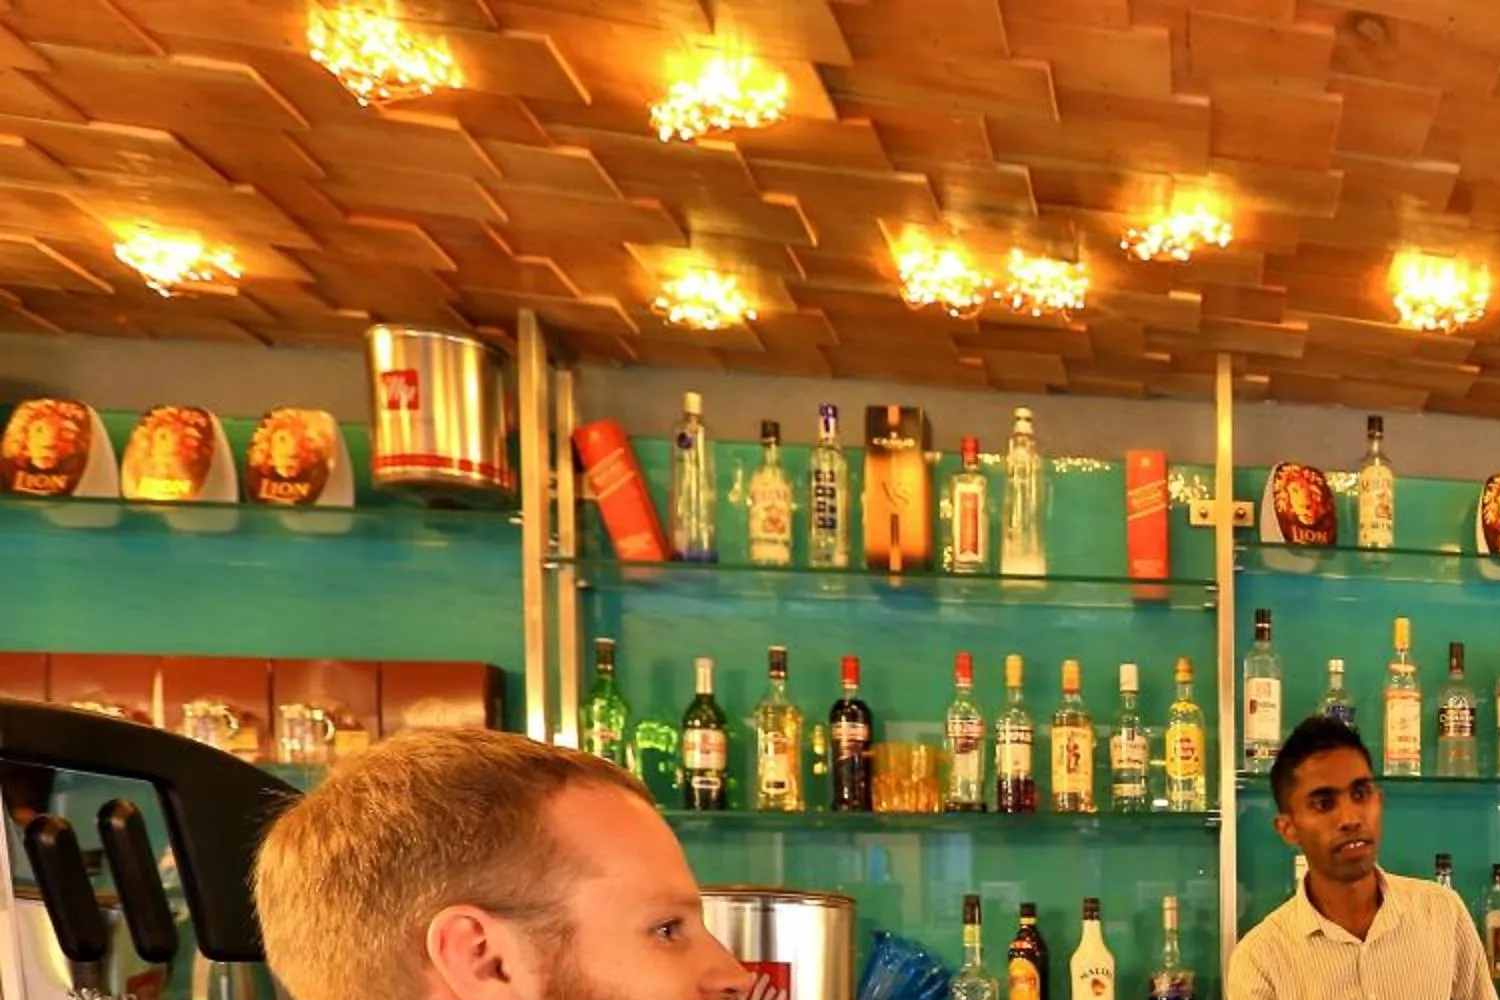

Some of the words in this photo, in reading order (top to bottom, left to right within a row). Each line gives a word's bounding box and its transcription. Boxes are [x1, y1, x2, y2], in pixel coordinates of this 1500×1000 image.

[12, 471, 67, 493] LION
[258, 478, 311, 500] LION
[1292, 525, 1328, 545] LION
